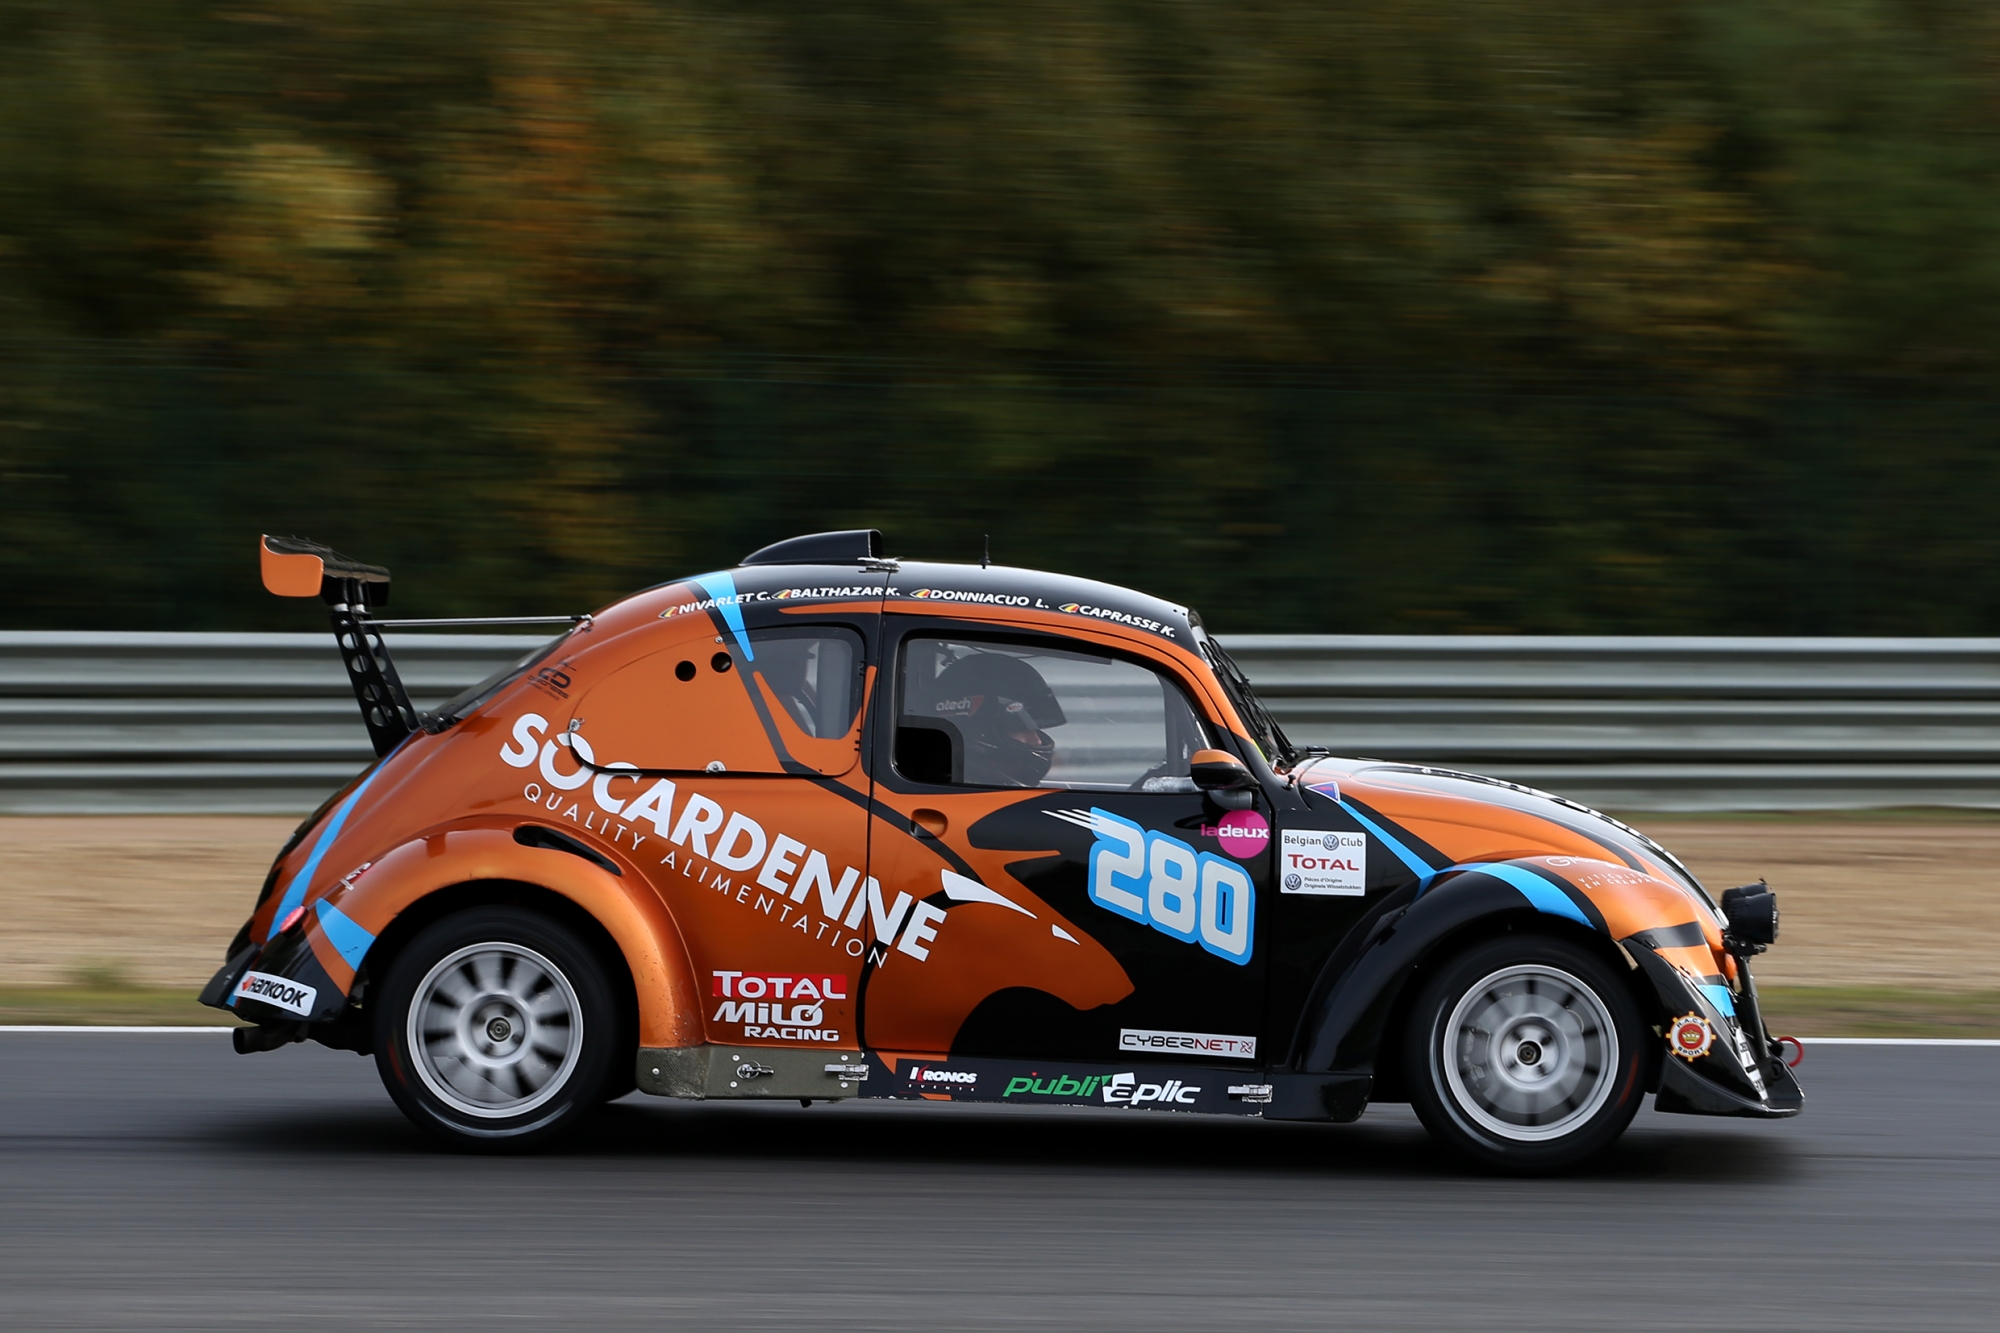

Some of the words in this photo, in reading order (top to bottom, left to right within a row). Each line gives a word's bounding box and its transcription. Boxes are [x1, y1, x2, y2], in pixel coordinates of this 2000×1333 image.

[790, 587, 884, 599] BALTHAZAR
[929, 589, 1030, 607] DONNIACUO
[1035, 598, 1050, 609] L.
[678, 593, 755, 615] NIVARLET
[1079, 605, 1160, 631] CAPRASSE
[499, 712, 948, 963] SOCARDENNE
[1283, 835, 1321, 847] Belgian
[1340, 837, 1364, 847] Club
[523, 782, 647, 852] QUALITY
[660, 850, 889, 969] ALIMENTATION
[1088, 808, 1255, 965] 280
[744, 1026, 840, 1042] RACING
[1122, 1034, 1239, 1052] CYBERNET
[1677, 1046, 1705, 1056] SPORT
[909, 1064, 978, 1084] KRONOS
[908, 1084, 977, 1092] EVENTS
